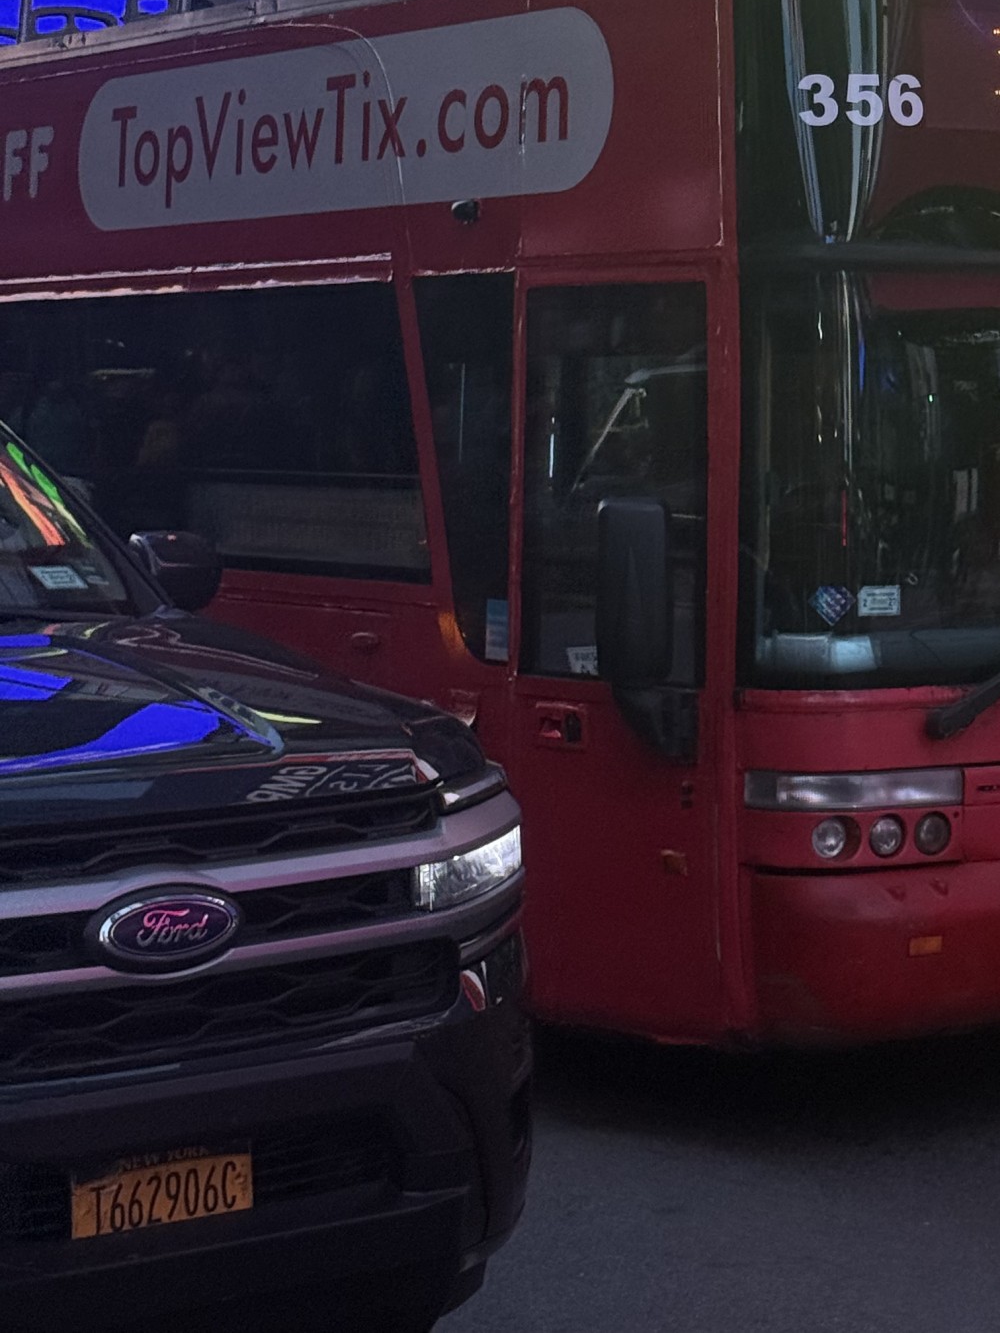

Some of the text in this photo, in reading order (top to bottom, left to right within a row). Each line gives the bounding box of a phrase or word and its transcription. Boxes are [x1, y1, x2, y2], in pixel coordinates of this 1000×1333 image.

[798, 73, 924, 127] 356
[111, 71, 571, 209] TopViewTix.com
[137, 907, 209, 947] Ford
[117, 1145, 210, 1174] NEW YORK
[91, 1161, 238, 1235] T662906C
